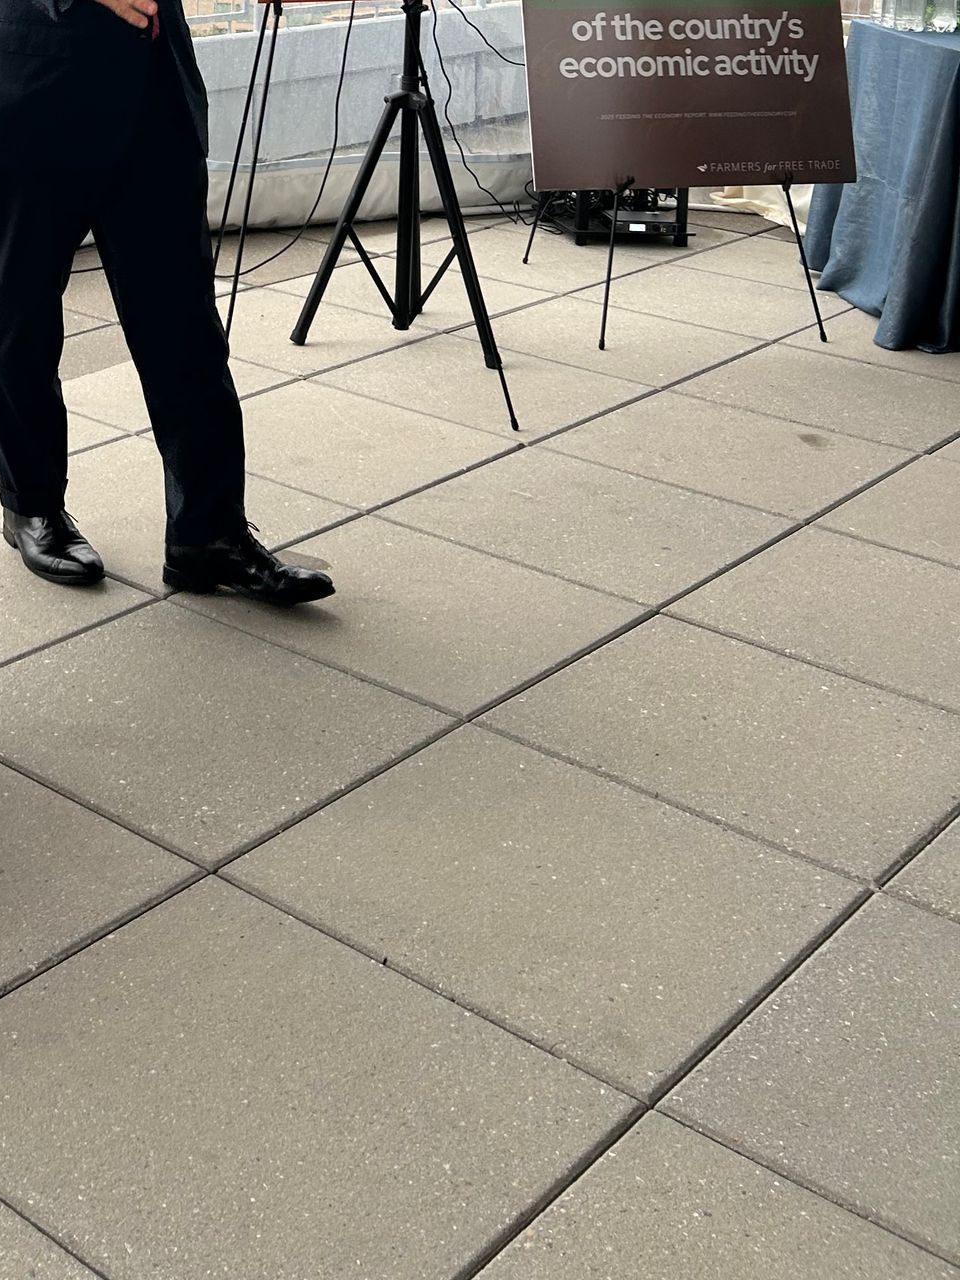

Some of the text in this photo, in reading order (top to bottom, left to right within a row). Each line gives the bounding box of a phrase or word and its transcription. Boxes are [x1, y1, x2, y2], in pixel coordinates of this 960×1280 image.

[571, 11, 805, 47] of the country's
[559, 47, 819, 83] economic activity
[710, 159, 841, 173] FARMERS for FREE TRADE
